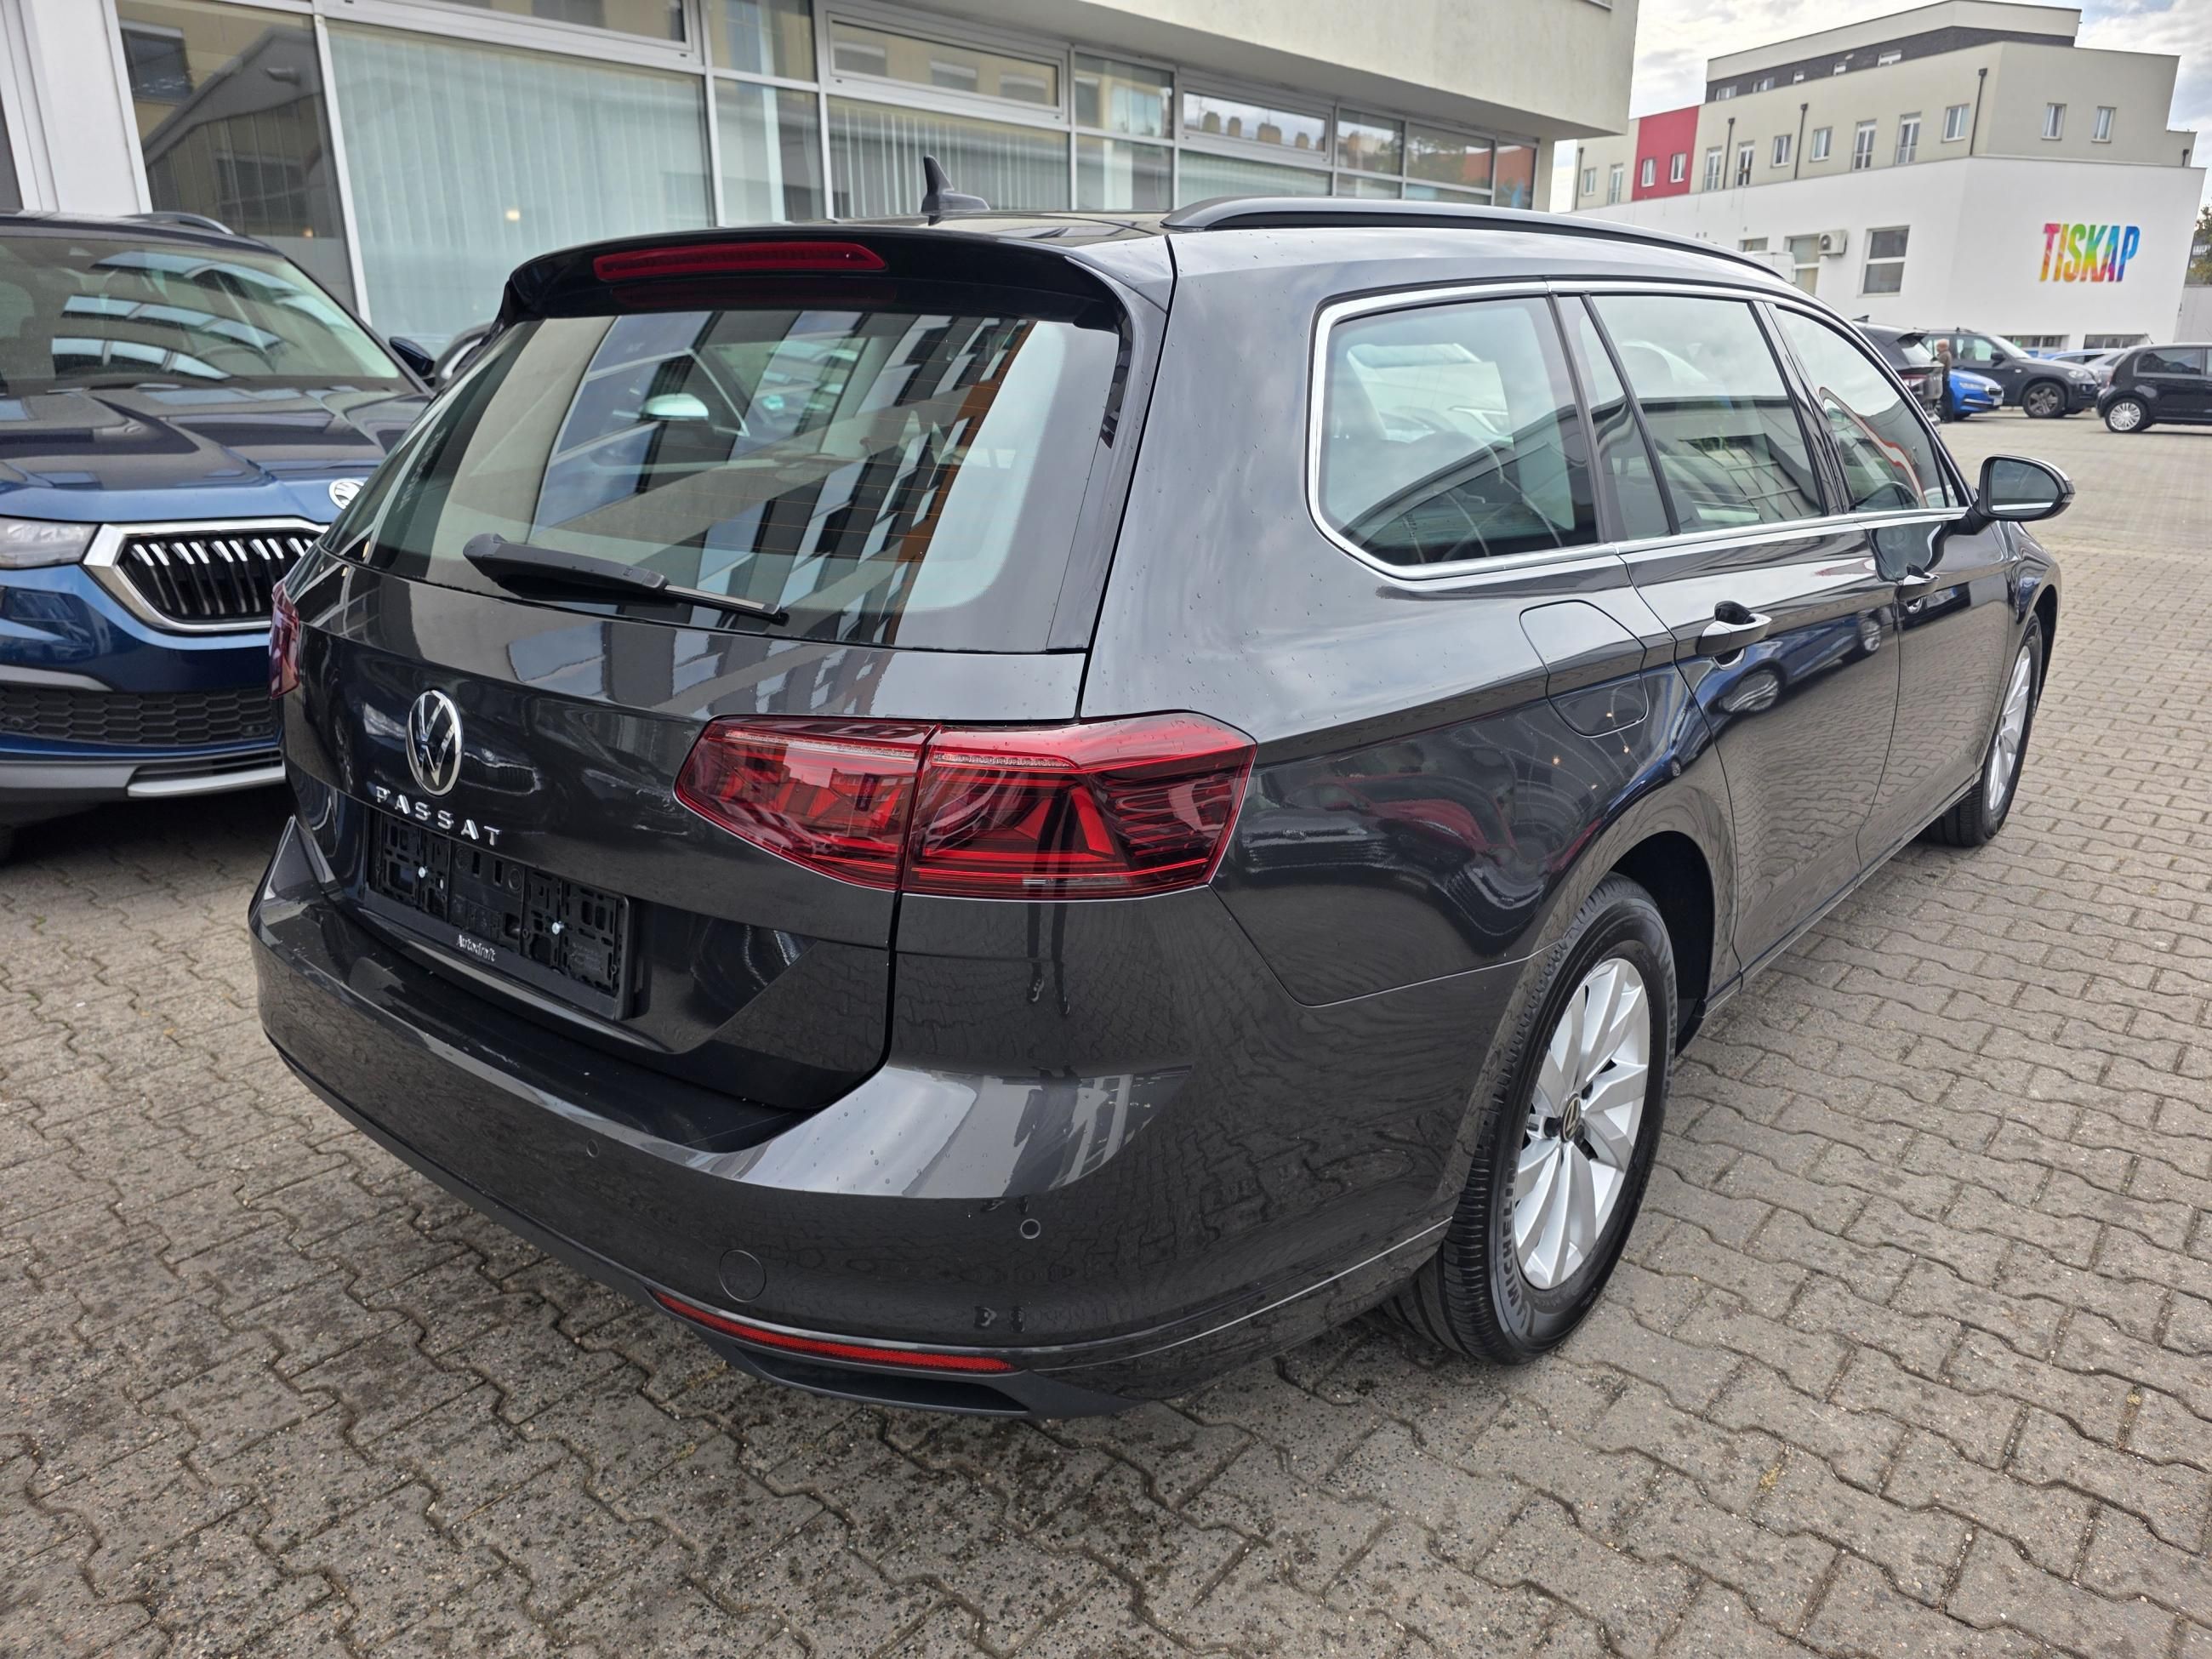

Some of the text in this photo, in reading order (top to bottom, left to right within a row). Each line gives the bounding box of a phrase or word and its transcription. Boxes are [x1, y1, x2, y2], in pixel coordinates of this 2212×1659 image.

[2039, 223, 2141, 282] TISKAP
[375, 785, 502, 846] PASSAT
[1502, 1159, 1520, 1308] MICHELIN
